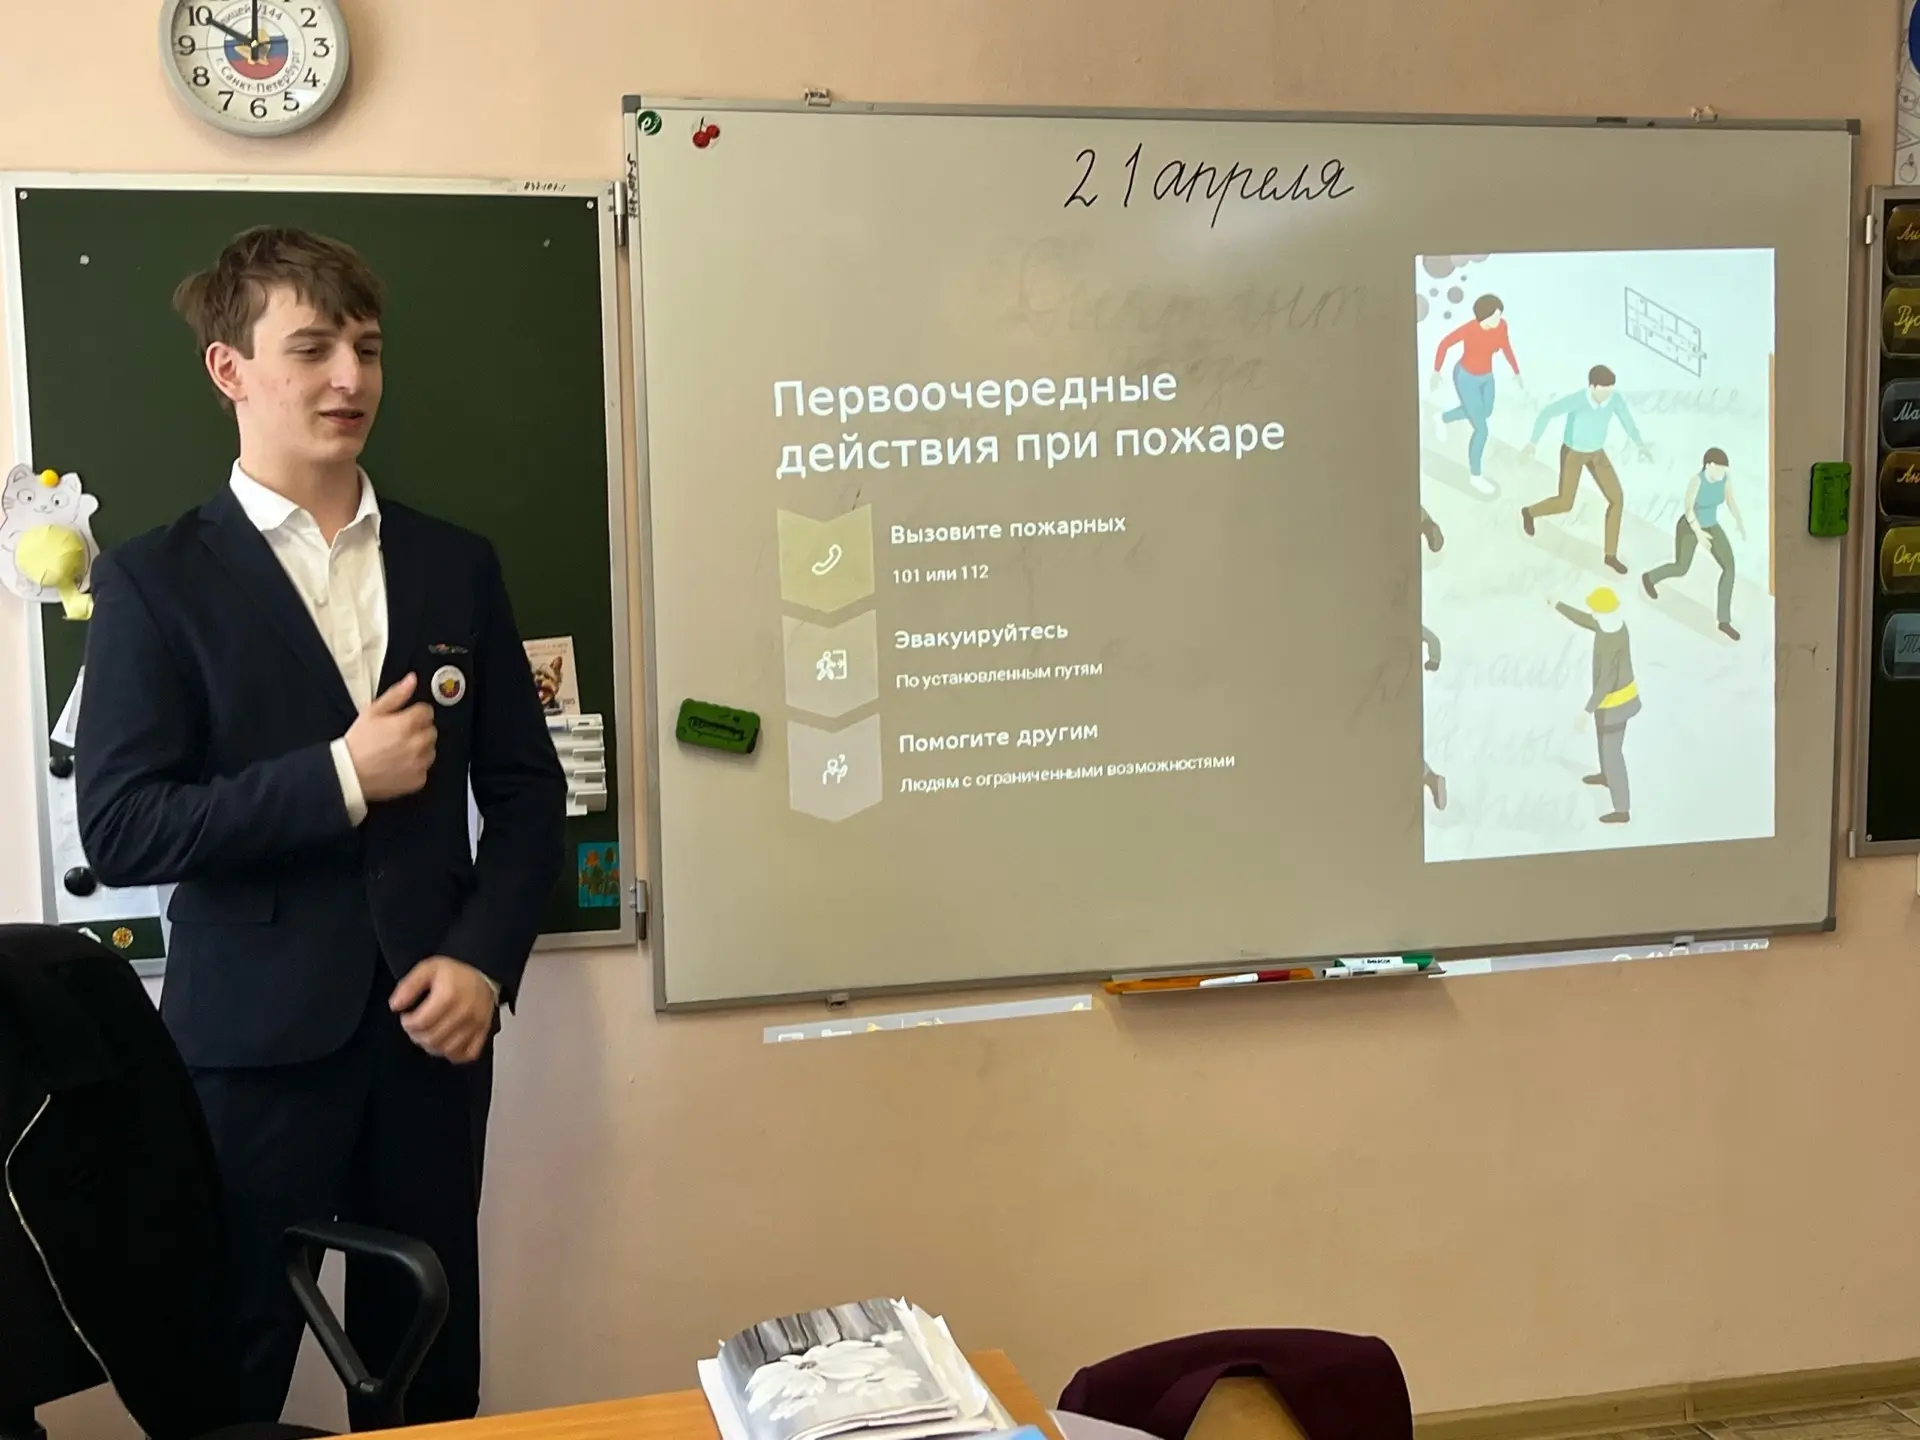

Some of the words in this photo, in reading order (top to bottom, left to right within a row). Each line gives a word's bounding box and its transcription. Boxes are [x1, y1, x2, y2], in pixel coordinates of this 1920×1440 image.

[188, 5, 212, 26] 10
[301, 7, 318, 28] 2
[178, 34, 196, 56] 9
[313, 37, 331, 58] 3
[192, 66, 211, 87] 8
[303, 67, 321, 88] 4
[217, 90, 234, 112] 7
[249, 97, 268, 119] 6
[283, 91, 300, 112] 5
[1153, 158, 1355, 228] апреля
[773, 371, 1178, 424] Первоочередные
[775, 431, 1000, 480] действия
[1016, 430, 1098, 470] при
[1116, 421, 1286, 460] пожаре
[890, 523, 1003, 545] Вызовите
[1009, 516, 1127, 538] пожарных
[892, 568, 921, 584] 101
[925, 567, 957, 582] или
[961, 564, 989, 580] 112
[894, 622, 1069, 650] Эвакуируйтесь
[896, 674, 920, 689] По
[922, 664, 1051, 690] установленным
[1054, 663, 1103, 681] путям
[899, 728, 1010, 753] Помогите
[1016, 723, 1099, 748] другим
[900, 776, 960, 793] Людям
[962, 775, 972, 788] с
[975, 764, 1104, 788] ограниченными
[1107, 754, 1236, 777] возможностями
